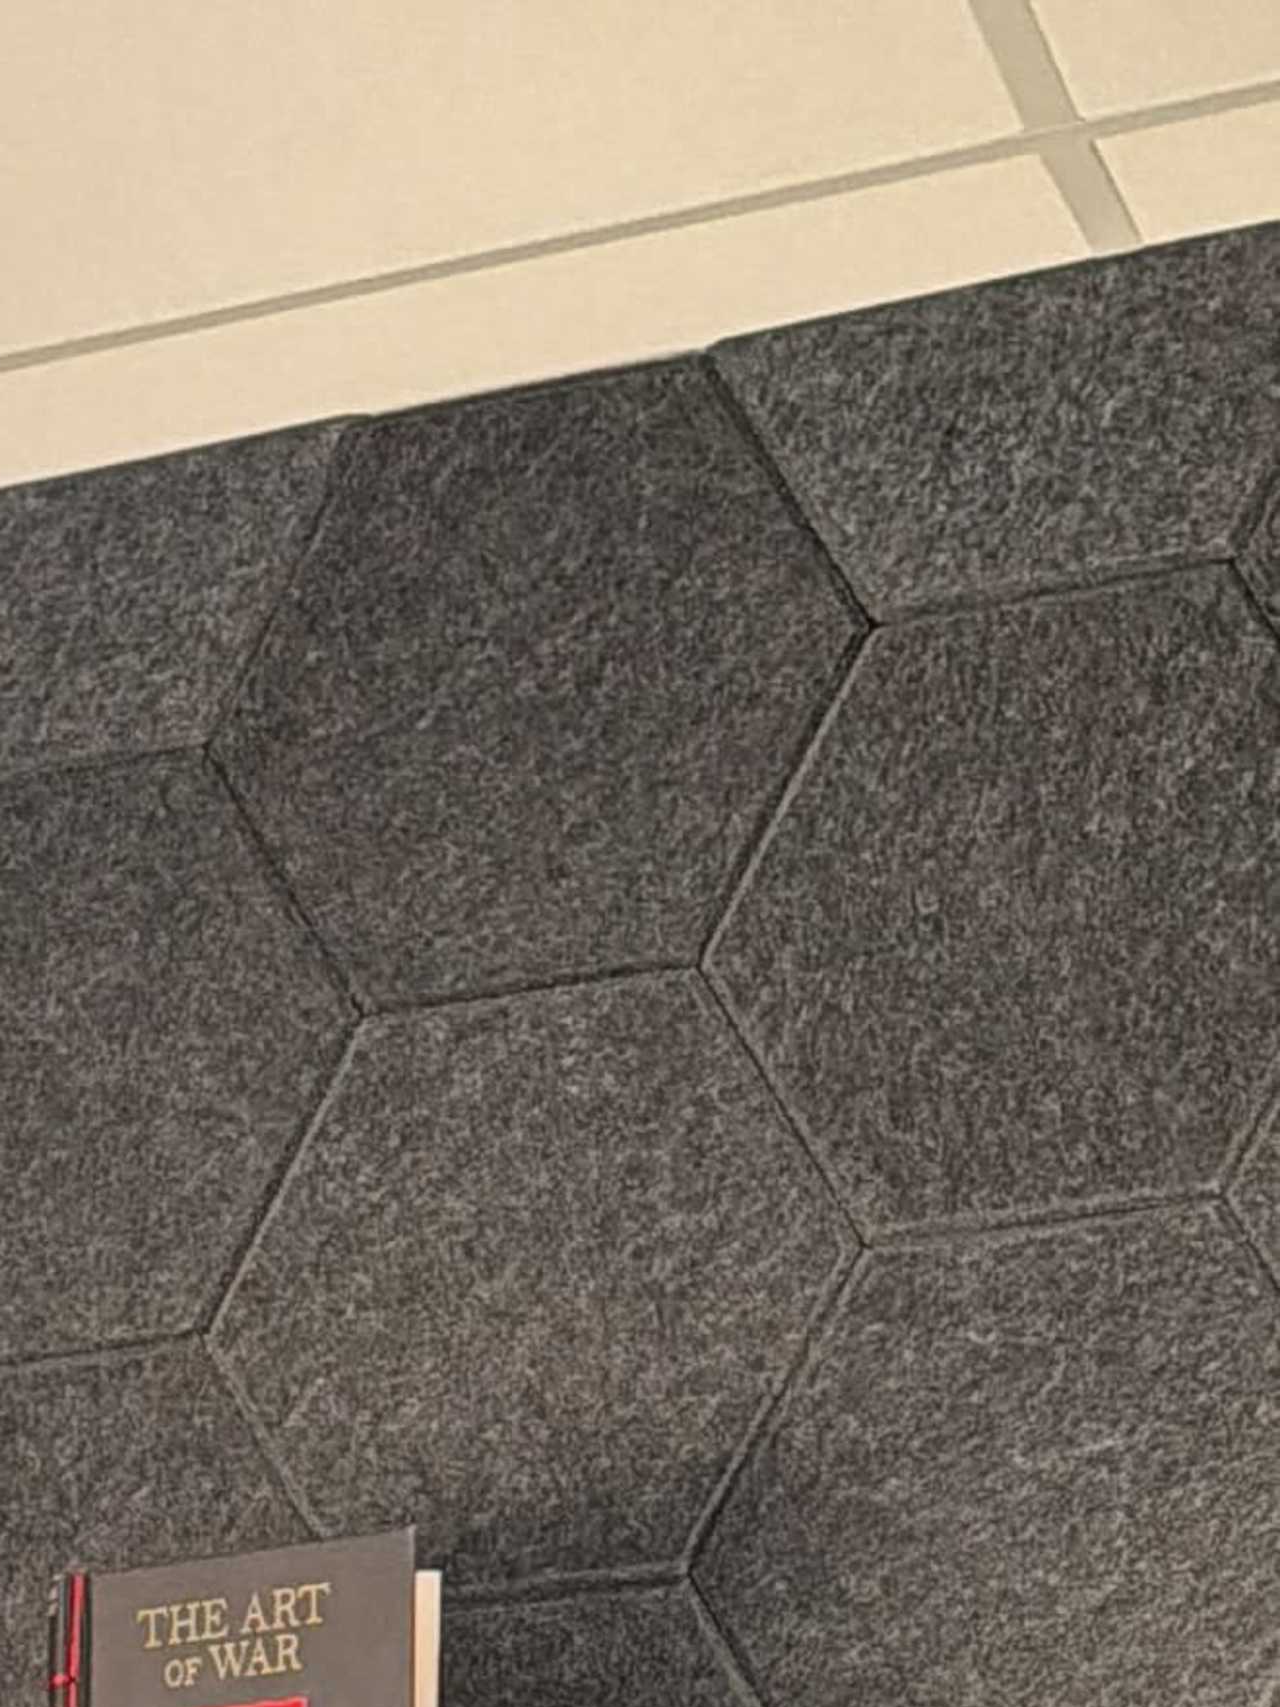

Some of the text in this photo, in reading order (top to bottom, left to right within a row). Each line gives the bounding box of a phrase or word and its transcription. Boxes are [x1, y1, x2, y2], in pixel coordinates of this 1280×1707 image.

[136, 1582, 331, 1648] THE ART
[164, 1633, 302, 1688] OF WAR
